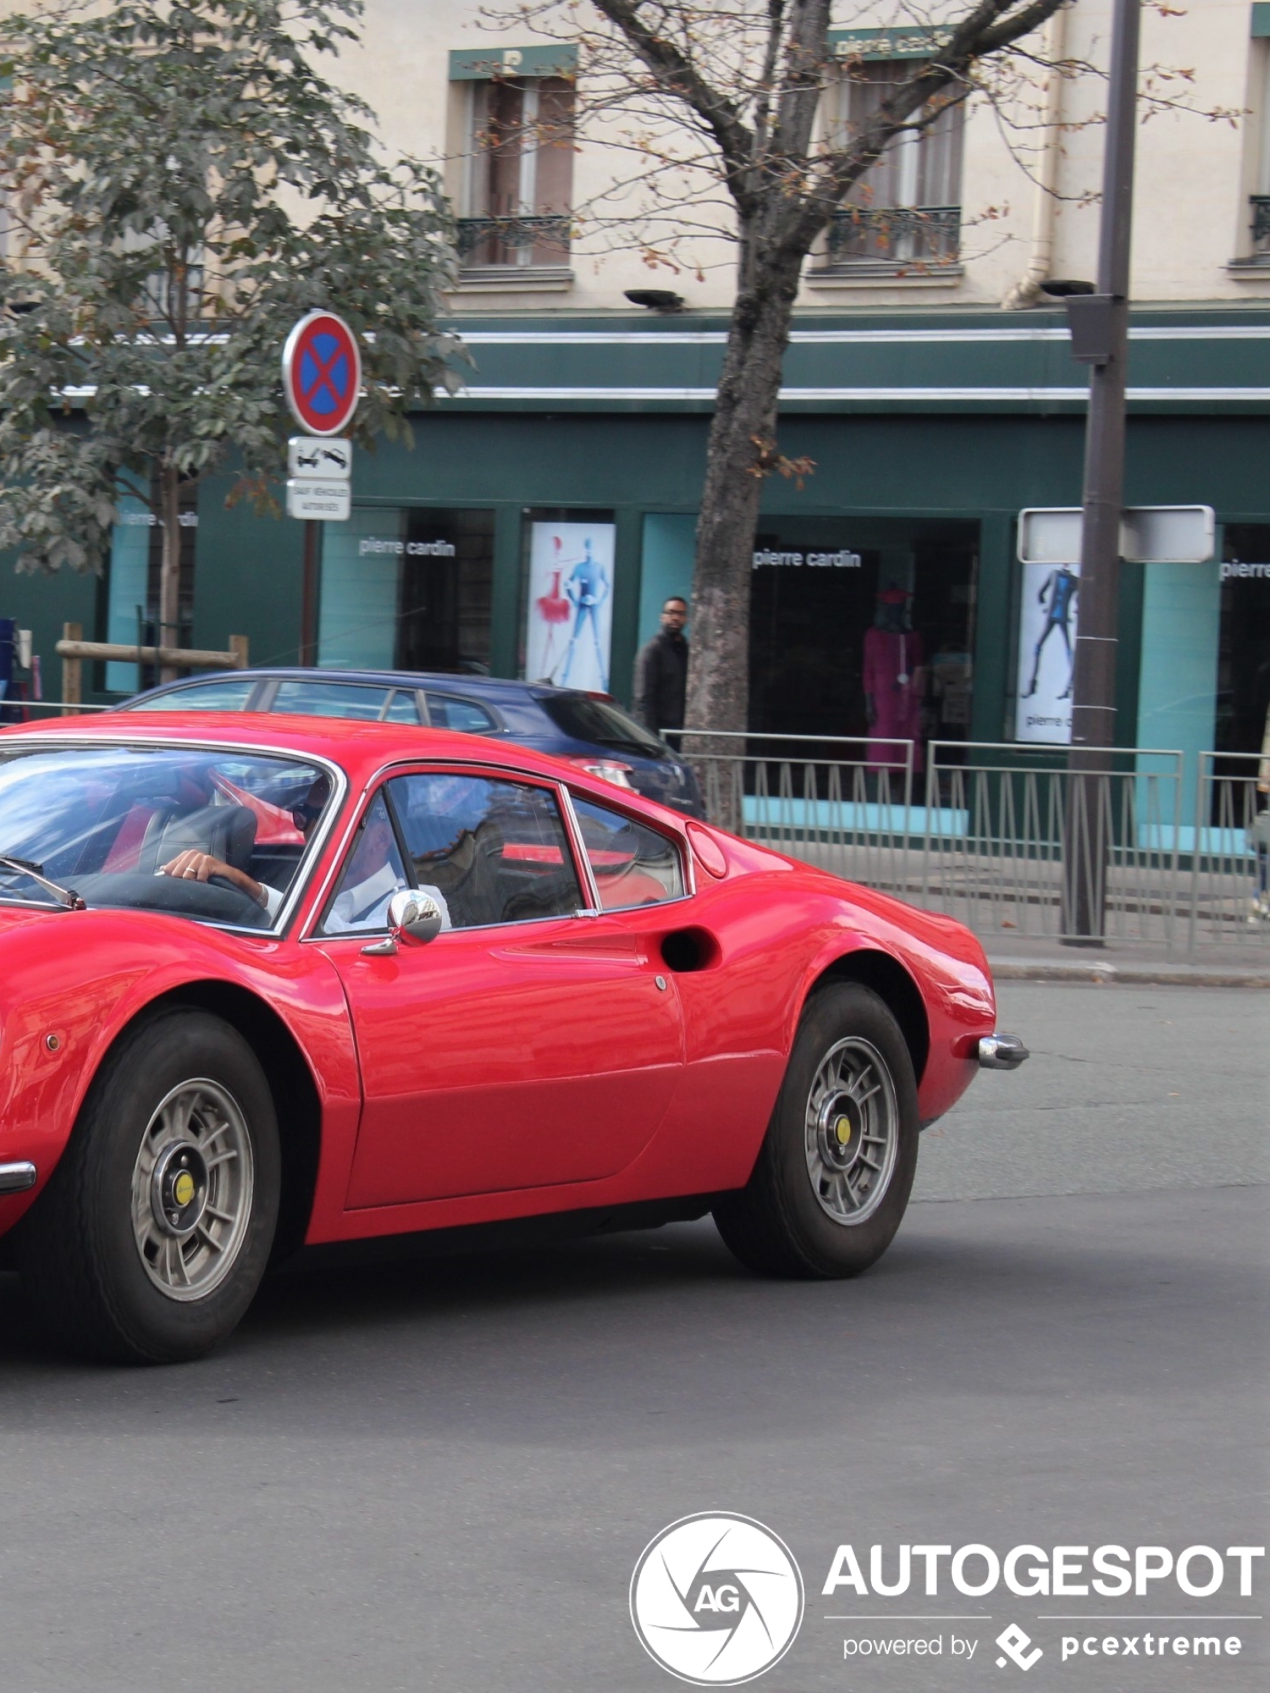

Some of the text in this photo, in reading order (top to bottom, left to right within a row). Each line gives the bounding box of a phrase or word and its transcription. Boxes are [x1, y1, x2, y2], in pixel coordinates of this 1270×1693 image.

[359, 537, 456, 557] pierre cardin
[752, 548, 861, 570] pierre cardin
